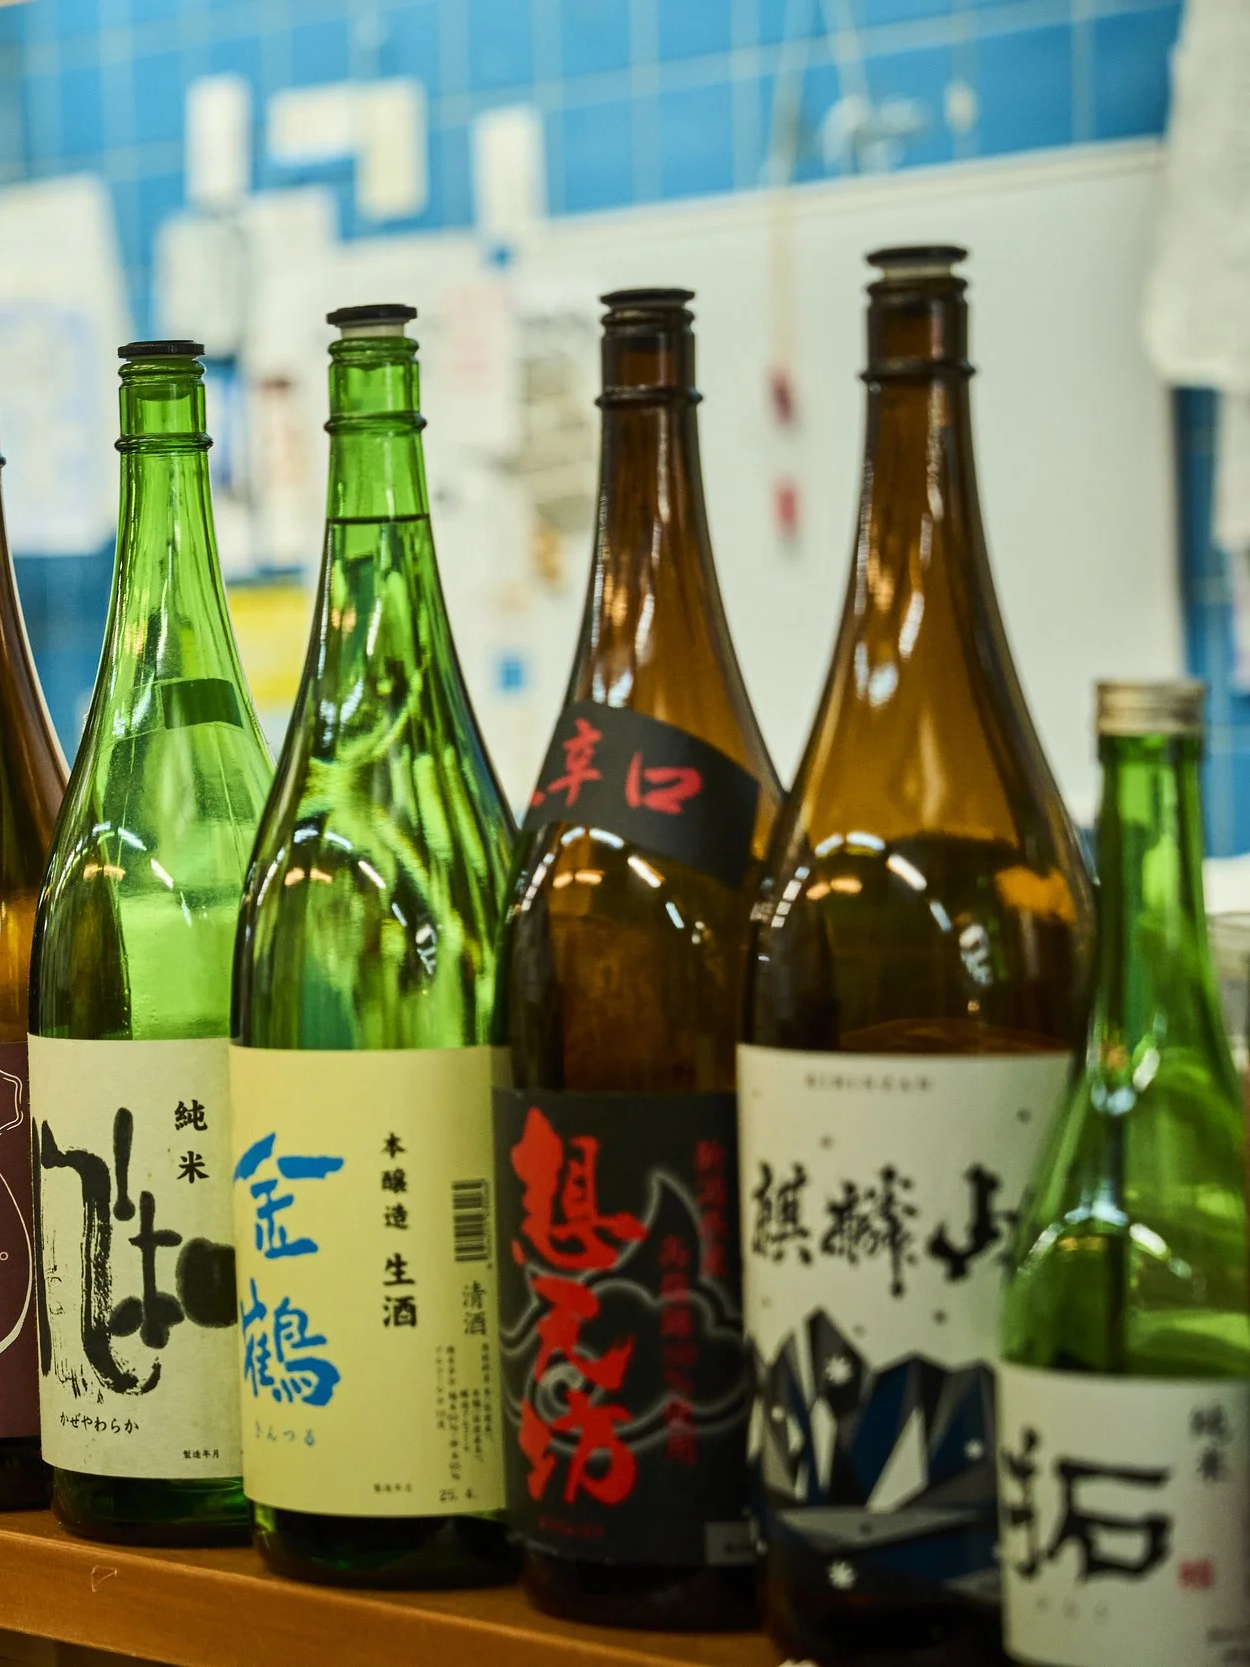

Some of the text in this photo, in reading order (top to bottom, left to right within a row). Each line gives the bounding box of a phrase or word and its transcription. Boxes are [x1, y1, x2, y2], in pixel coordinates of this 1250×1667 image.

[531, 718, 703, 815] 辛口
[174, 1099, 210, 1184] 純米
[233, 1132, 344, 1407] 金鶴
[381, 1132, 417, 1329] 本醸造 生酒
[462, 1280, 487, 1335] 清酒
[59, 1411, 140, 1435] かぜやわらか
[183, 1449, 220, 1460] 製造年月
[1003, 1427, 1173, 1583] 拓
